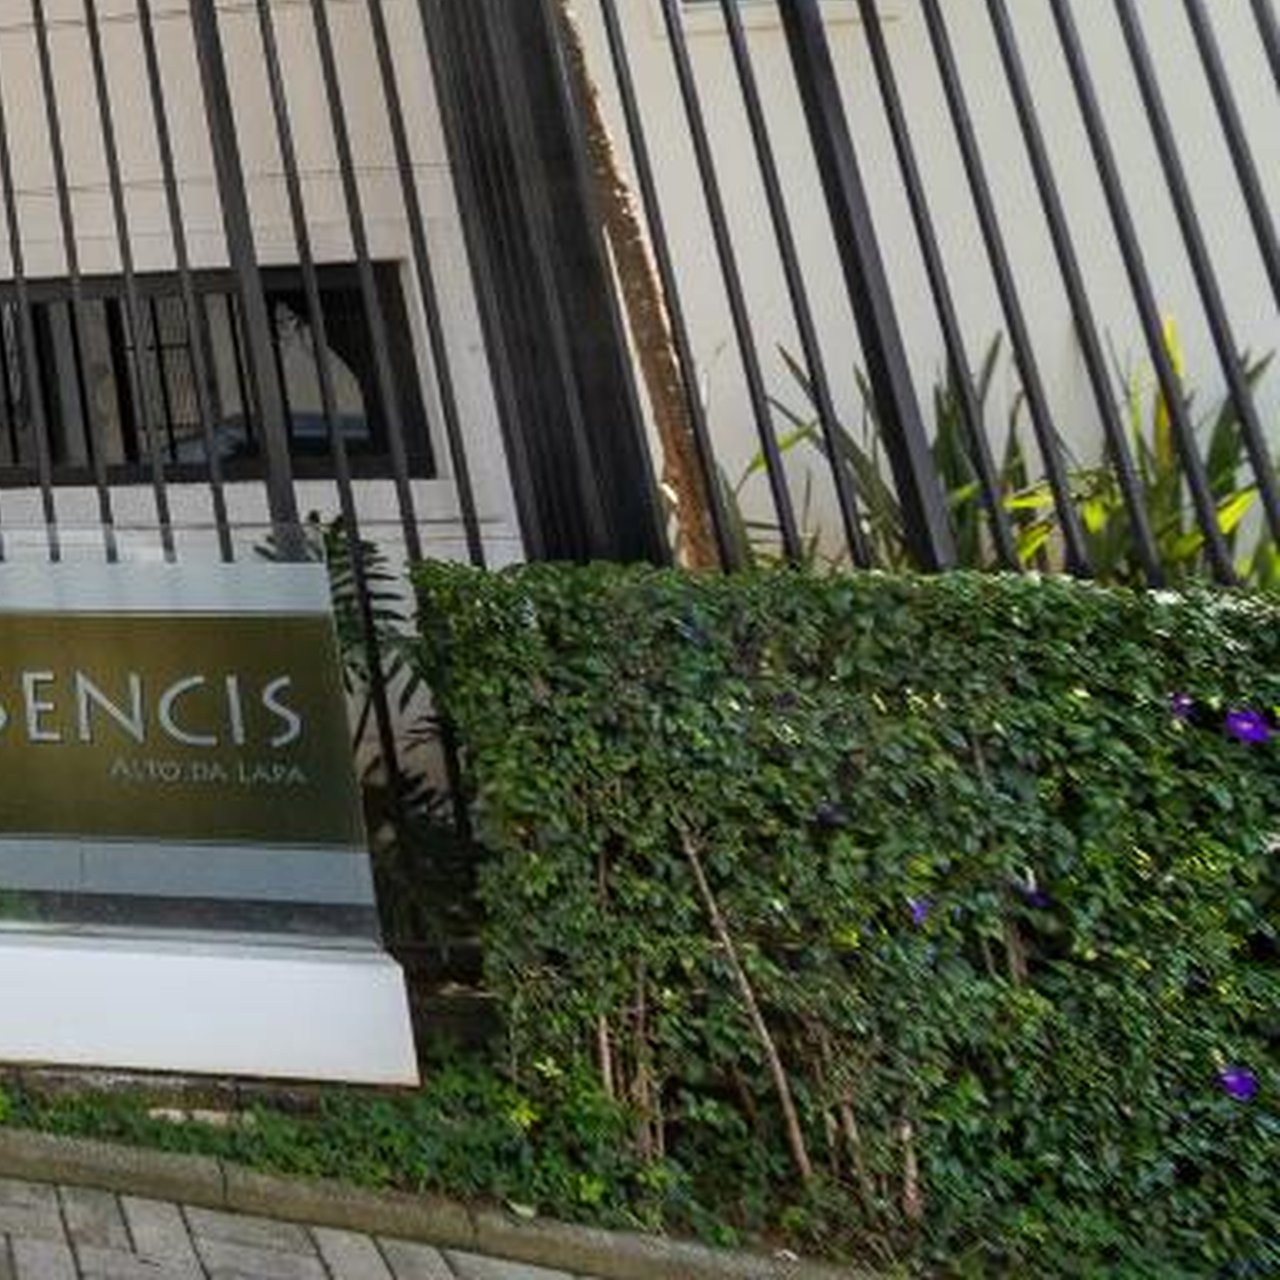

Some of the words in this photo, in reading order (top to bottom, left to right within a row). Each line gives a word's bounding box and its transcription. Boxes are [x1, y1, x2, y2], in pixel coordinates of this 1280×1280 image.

[108, 756, 182, 783] ALTO
[191, 759, 229, 783] DA
[237, 760, 309, 785] LAPA
